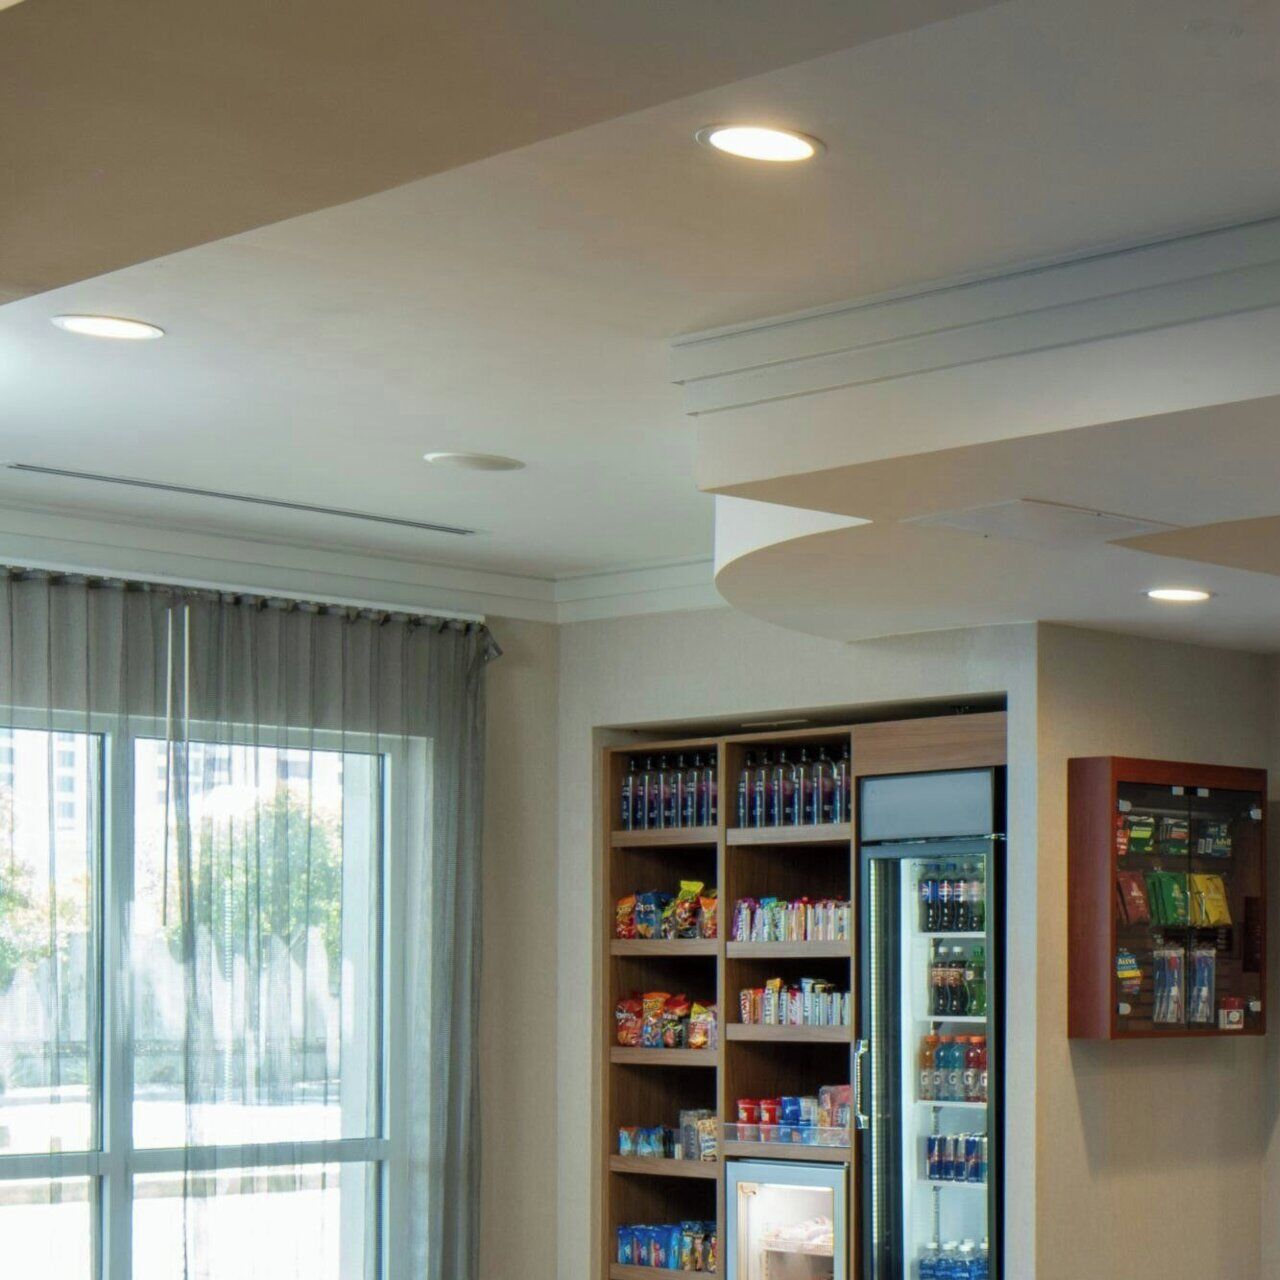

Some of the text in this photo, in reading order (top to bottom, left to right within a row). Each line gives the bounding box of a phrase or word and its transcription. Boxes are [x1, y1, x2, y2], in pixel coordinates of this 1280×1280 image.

[920, 1072, 928, 1085] G
[933, 1072, 942, 1085] G
[948, 1072, 957, 1085] G
[963, 1071, 973, 1085] G
